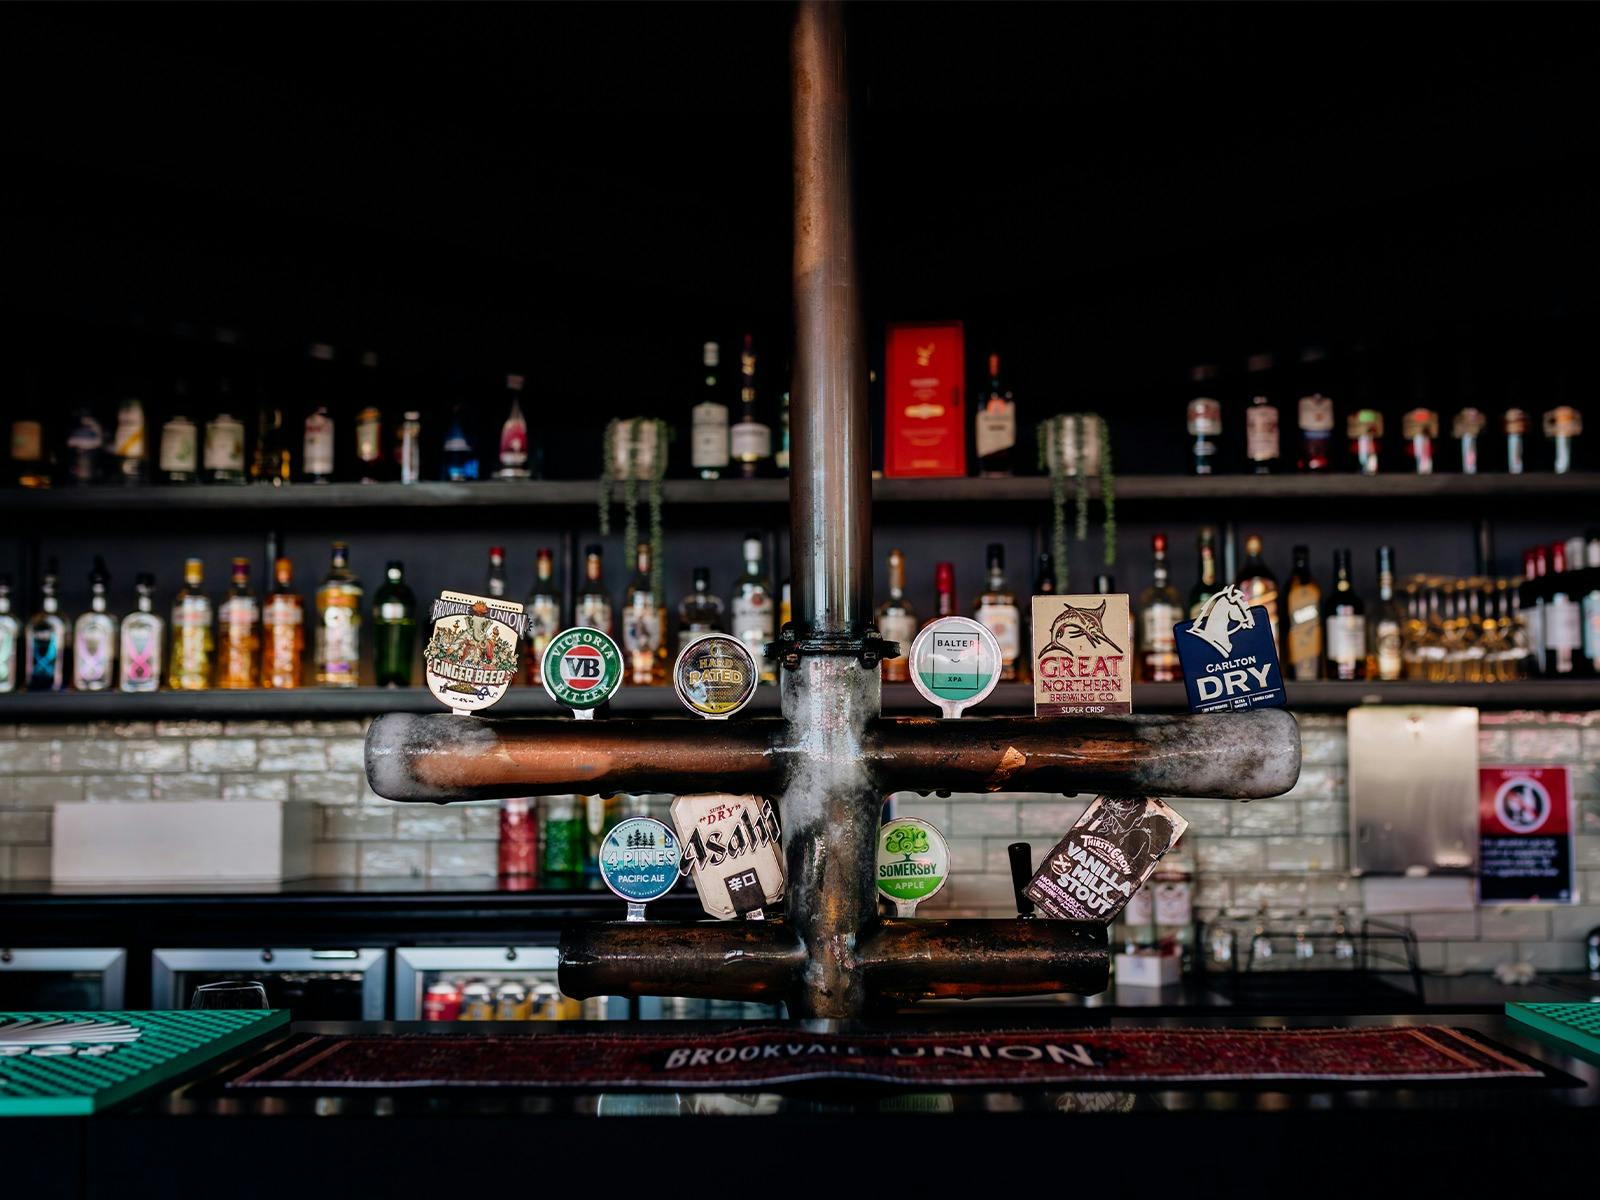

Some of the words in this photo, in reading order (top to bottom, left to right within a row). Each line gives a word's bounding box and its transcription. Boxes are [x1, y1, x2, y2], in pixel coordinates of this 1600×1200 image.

[432, 600, 470, 620] BROOKVALE
[489, 609, 527, 639] UNION
[552, 633, 614, 659] VICTORIA
[433, 658, 473, 682] GINGER
[475, 669, 506, 684] BEER
[565, 657, 600, 678] VB
[699, 658, 733, 668] HARD
[1039, 656, 1123, 678] GREAT
[1206, 656, 1257, 673] CARLTON
[689, 669, 743, 684] RATED
[1042, 680, 1122, 692] NORTHERN
[1196, 663, 1272, 701] DRY
[554, 682, 609, 702] BITTER
[1050, 693, 1095, 702] BREWING
[1098, 693, 1116, 701] CO.
[1061, 706, 1084, 714] SUPER
[1085, 705, 1105, 713] CRISP
[709, 804, 726, 814] SUPER
[680, 799, 780, 876] Asahi
[607, 850, 618, 868] 4
[623, 850, 676, 868] PINES
[650, 874, 665, 882] ALE
[880, 863, 936, 877] SOMERSBY
[1067, 841, 1131, 897] VANILLA
[728, 872, 757, 891] 辛口
[895, 881, 924, 890] APPLE
[1071, 865, 1113, 899] MILK
[1056, 874, 1113, 915] STOUT
[890, 1044, 1095, 1067] UNION
